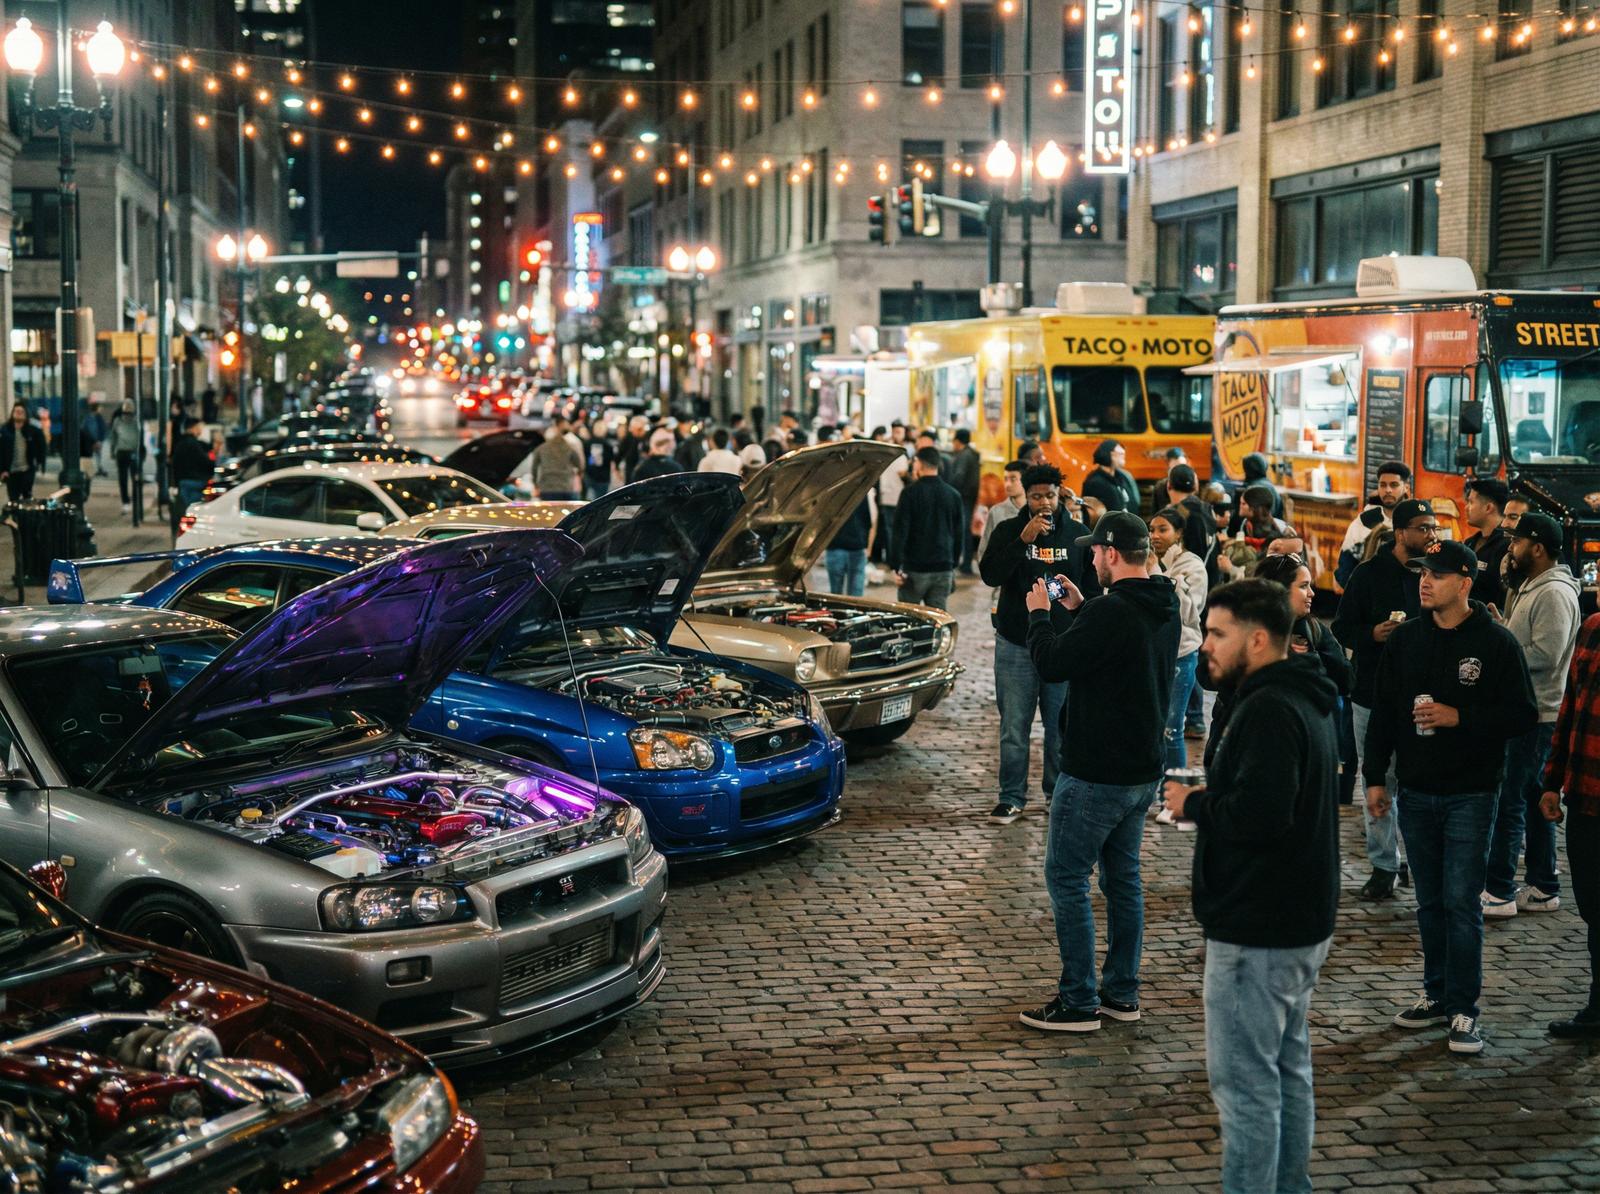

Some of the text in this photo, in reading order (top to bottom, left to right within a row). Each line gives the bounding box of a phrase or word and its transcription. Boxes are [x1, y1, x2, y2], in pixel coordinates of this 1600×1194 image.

[1063, 337, 1212, 356] TACO MOTO
[1515, 321, 1600, 347] STREET
[1222, 371, 1257, 406] TACO
[1222, 405, 1259, 441] MOTO
